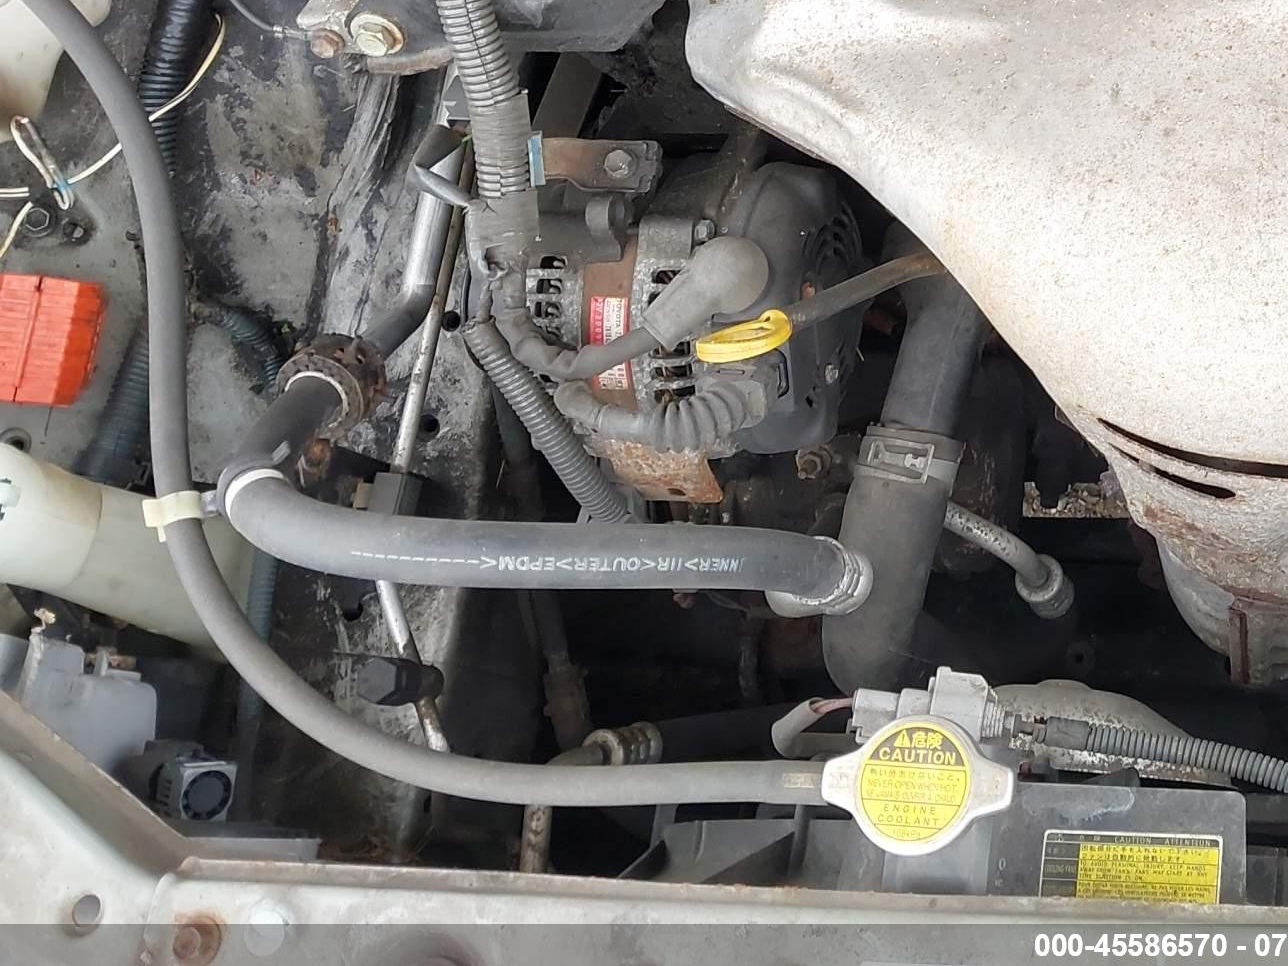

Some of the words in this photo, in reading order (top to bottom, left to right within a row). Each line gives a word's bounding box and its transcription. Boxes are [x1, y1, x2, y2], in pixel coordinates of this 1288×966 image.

[911, 730, 944, 750] 危険
[878, 746, 957, 766] CAUTION
[867, 778, 893, 789] NEVER
[895, 780, 916, 791] OPEN
[883, 803, 937, 816] ENGINE
[877, 813, 940, 827] COOLANT
[1114, 835, 1152, 846] CAUTION
[1164, 837, 1211, 848] ATTENTION
